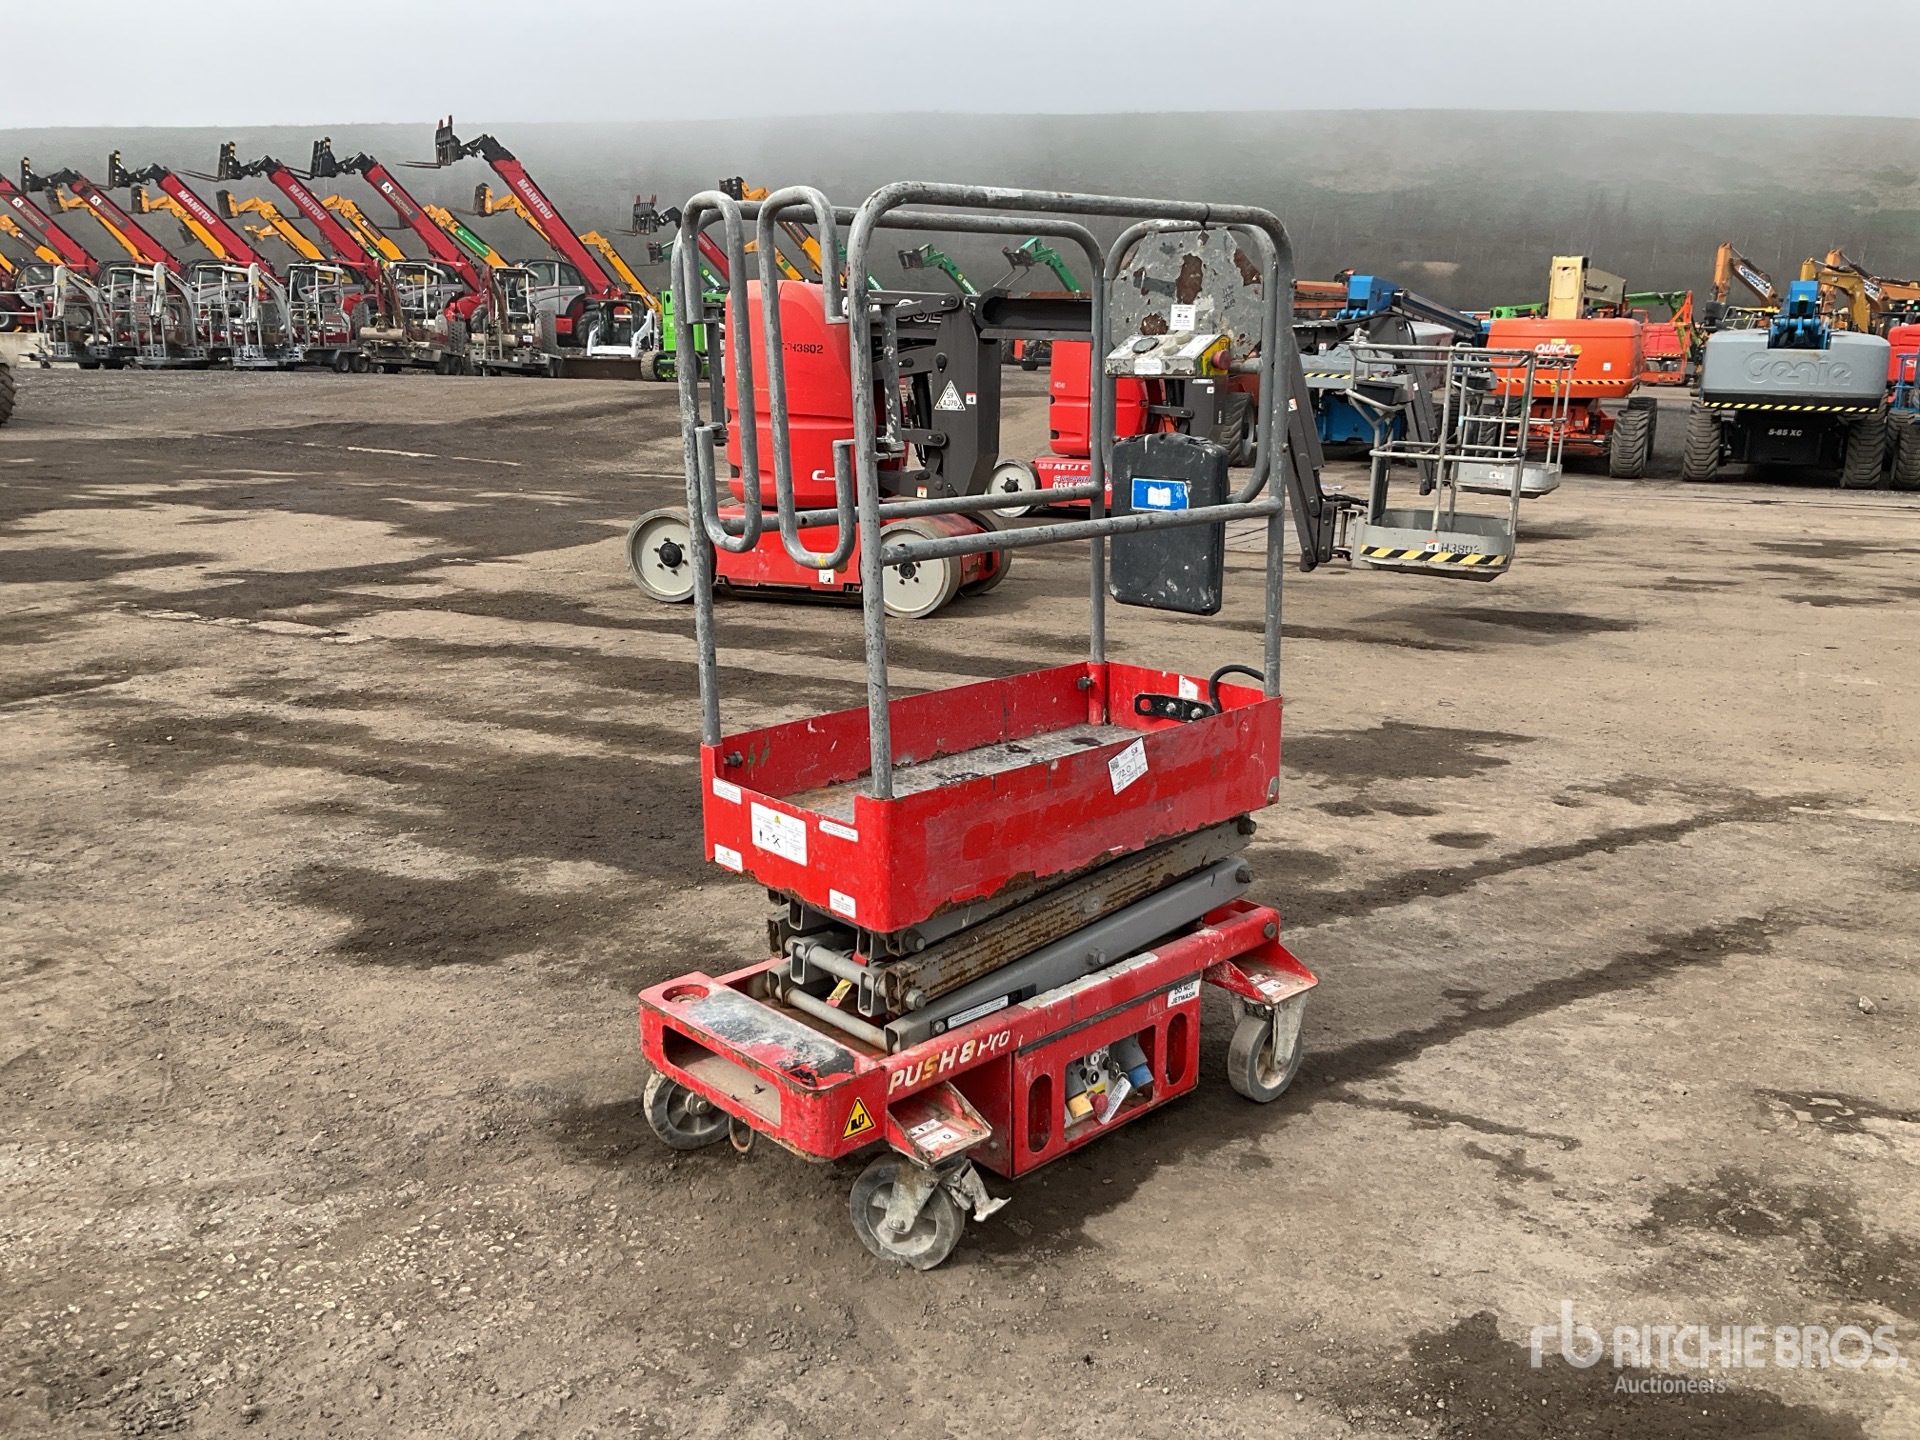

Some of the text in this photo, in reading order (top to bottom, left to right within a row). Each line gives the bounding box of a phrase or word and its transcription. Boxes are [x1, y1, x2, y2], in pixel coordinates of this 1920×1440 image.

[177, 190, 216, 225] MANITOU
[289, 184, 326, 221] MANITOU
[517, 179, 553, 220] MANITOU
[1535, 344, 1573, 354] QUICK
[1743, 352, 1851, 386] Genie
[1790, 429, 1803, 437] XC
[888, 1046, 958, 1095] PUSH
[959, 1039, 977, 1064] 8
